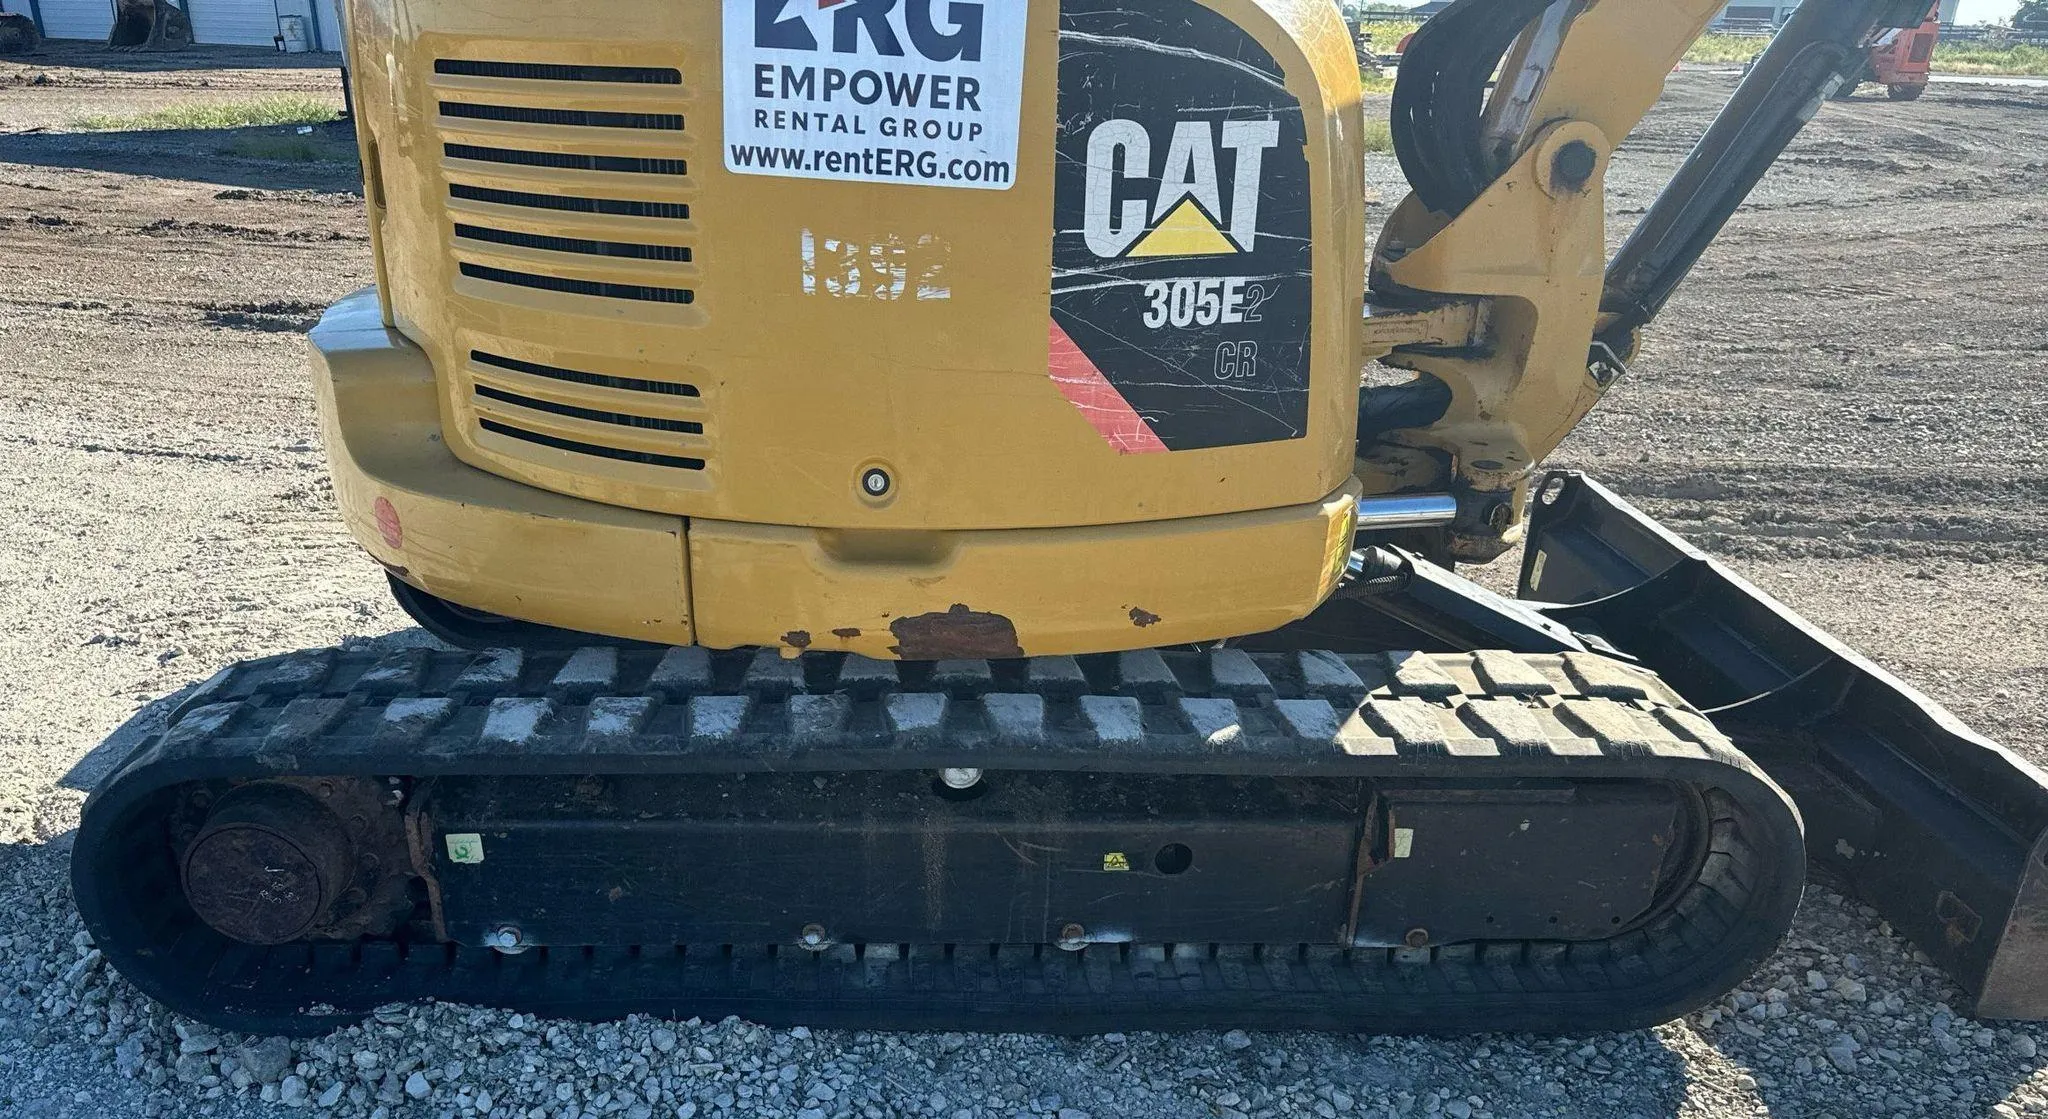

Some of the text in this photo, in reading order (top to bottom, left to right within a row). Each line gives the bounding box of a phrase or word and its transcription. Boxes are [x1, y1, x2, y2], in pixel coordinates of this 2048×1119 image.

[754, 64, 982, 111] EMPOWER
[755, 109, 983, 141] RENTAL GROUP
[730, 144, 1010, 183] www.rentERG.com
[1083, 118, 1280, 258] CAT
[1143, 276, 1266, 328] 305E2
[1213, 341, 1258, 379] CR
